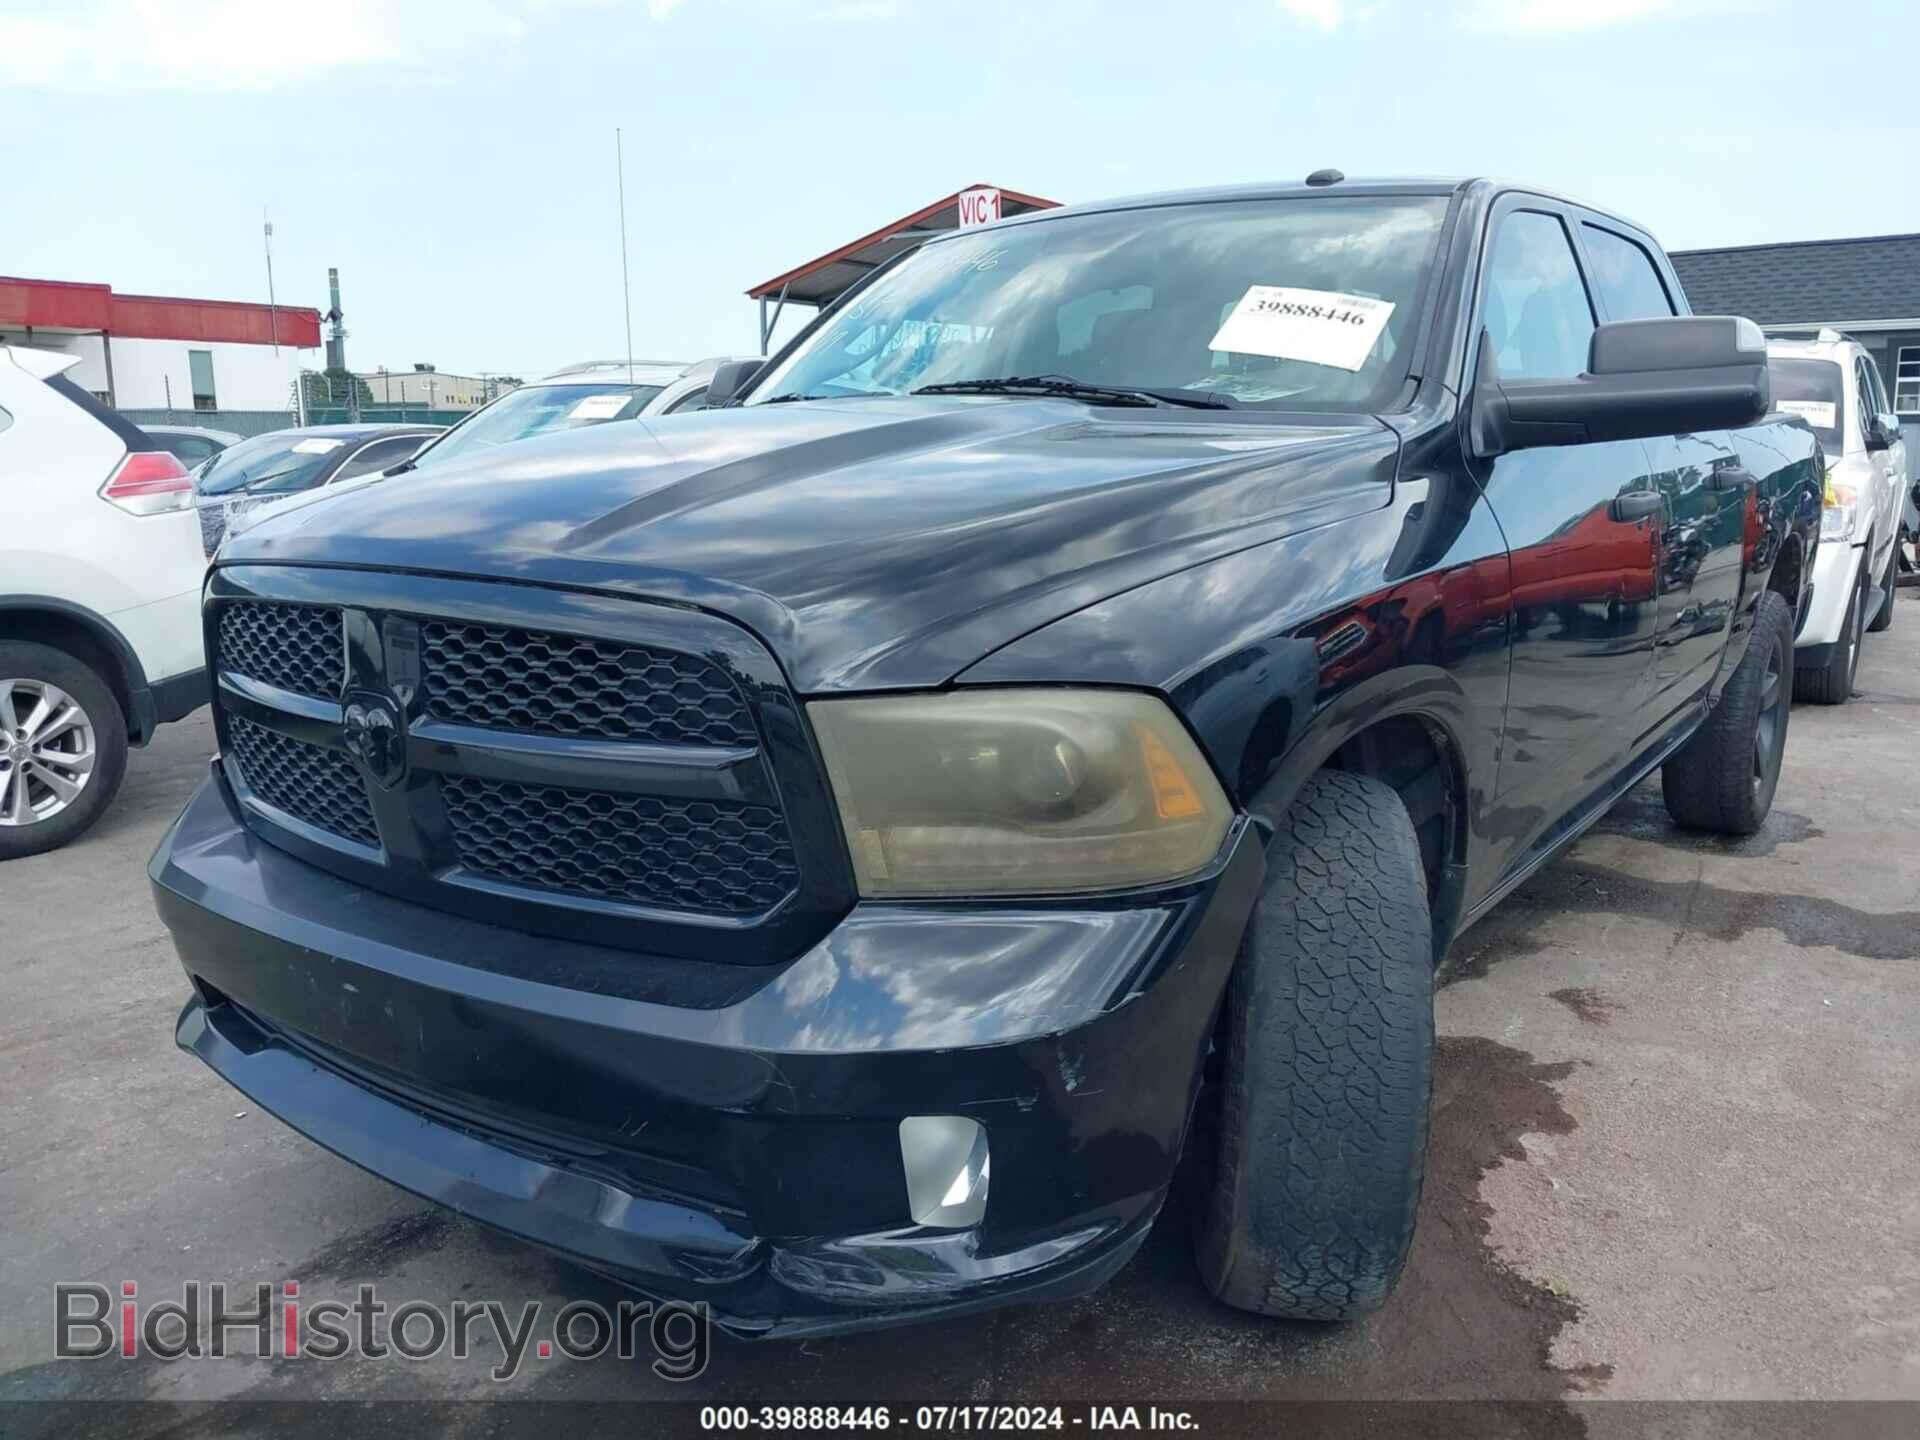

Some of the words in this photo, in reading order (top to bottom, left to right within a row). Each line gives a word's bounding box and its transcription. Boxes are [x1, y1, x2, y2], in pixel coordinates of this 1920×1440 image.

[960, 195, 987, 224] VIC
[991, 193, 1000, 220] 1
[1250, 299, 1365, 326] 39888446
